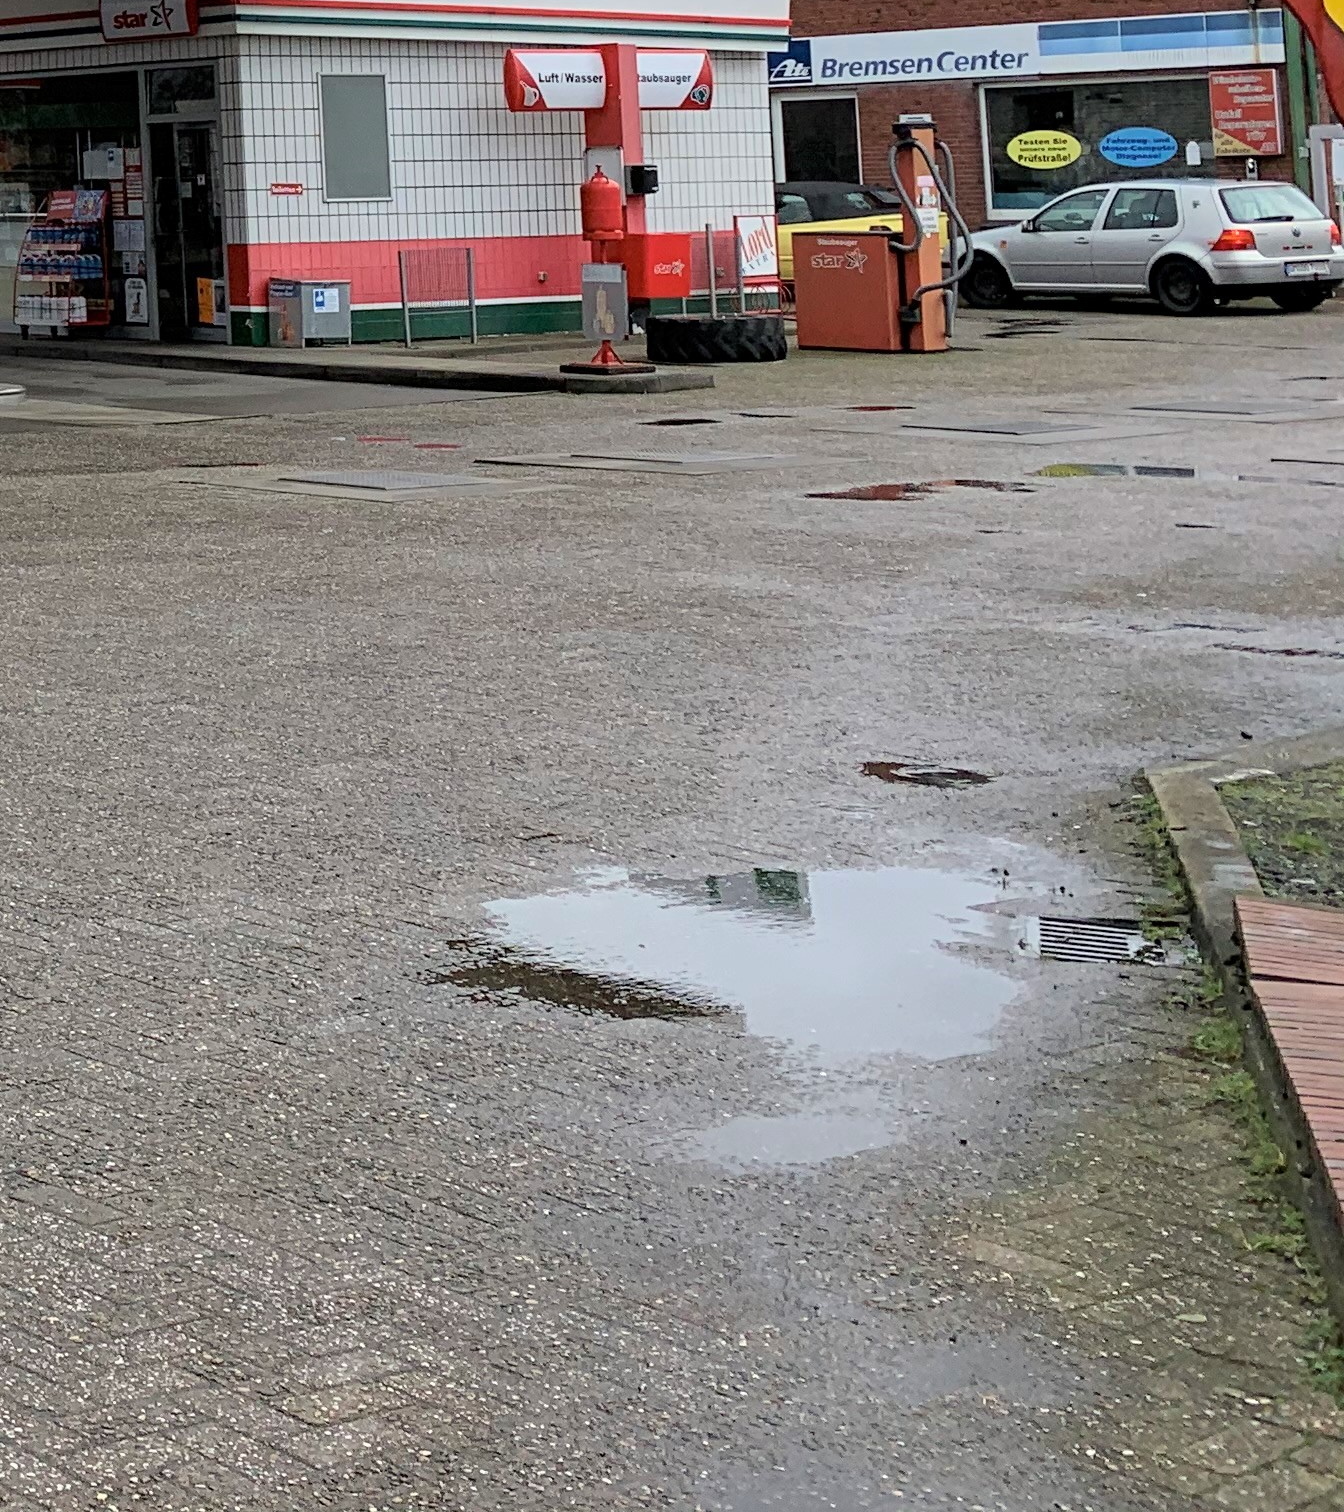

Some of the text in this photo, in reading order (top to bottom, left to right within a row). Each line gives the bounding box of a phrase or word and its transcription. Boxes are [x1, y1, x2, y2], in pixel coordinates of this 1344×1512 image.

[113, 9, 148, 29] star
[637, 73, 692, 86] taubsauger
[1018, 153, 1071, 163] Prüfstraße!
[812, 252, 842, 268] star
